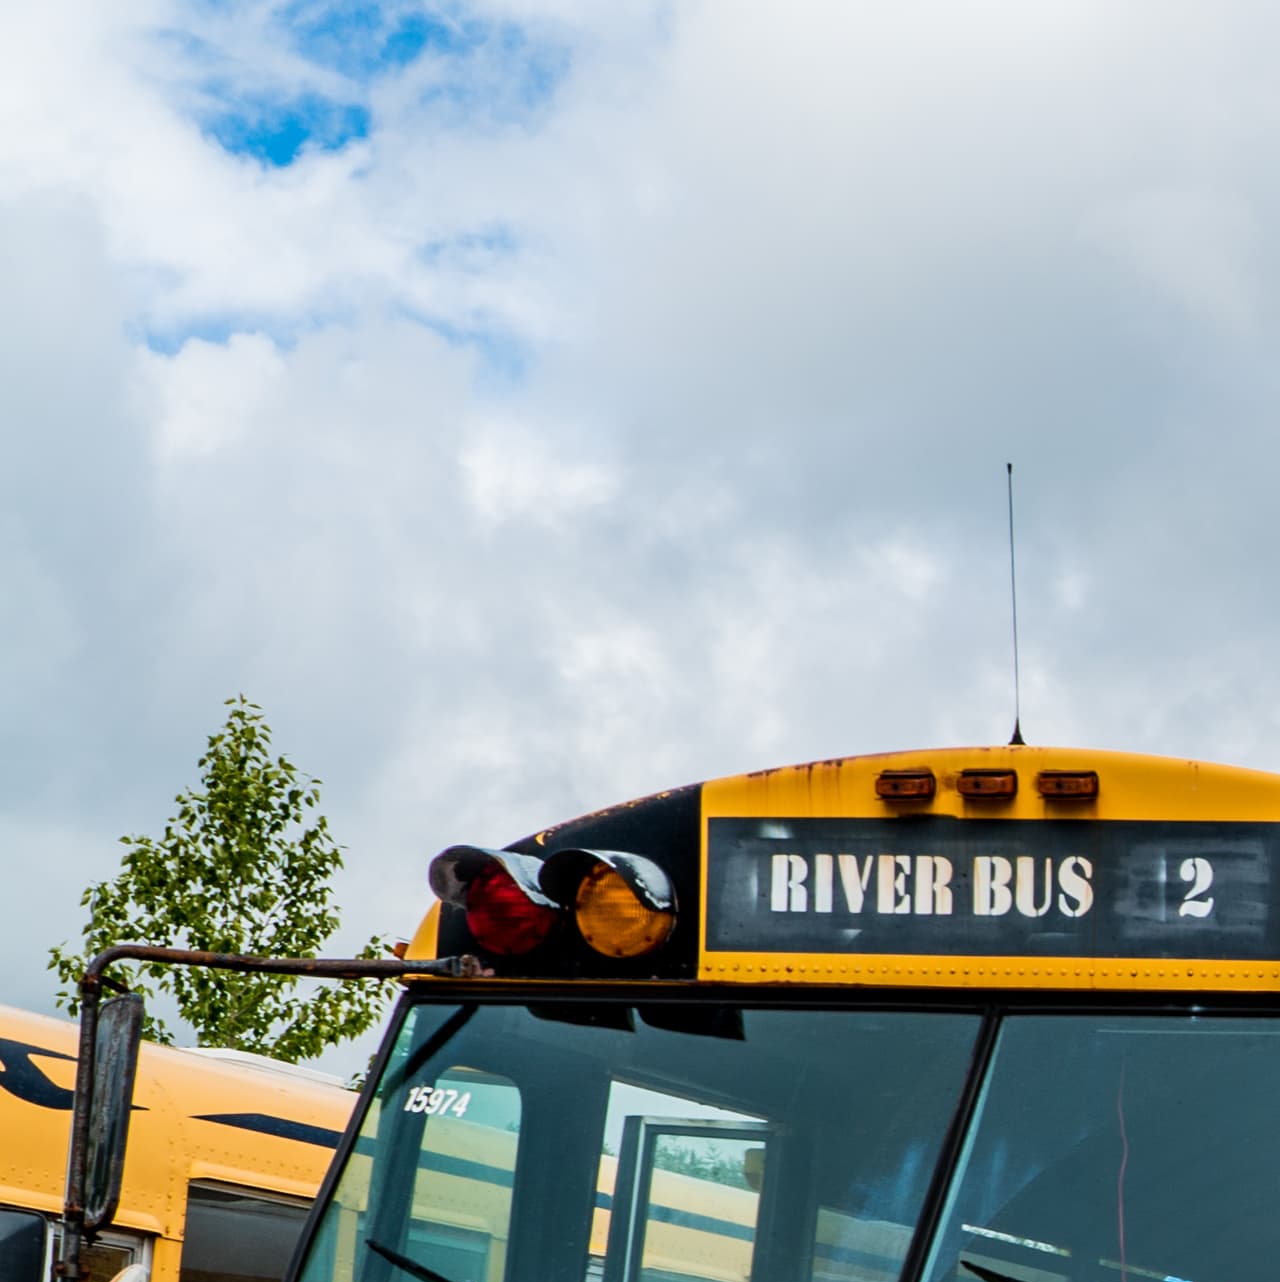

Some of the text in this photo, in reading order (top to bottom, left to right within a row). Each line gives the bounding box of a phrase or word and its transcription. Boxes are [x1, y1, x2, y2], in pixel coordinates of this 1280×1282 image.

[770, 854, 1214, 917] RIVER BUS 2
[403, 1086, 471, 1118] 15974
